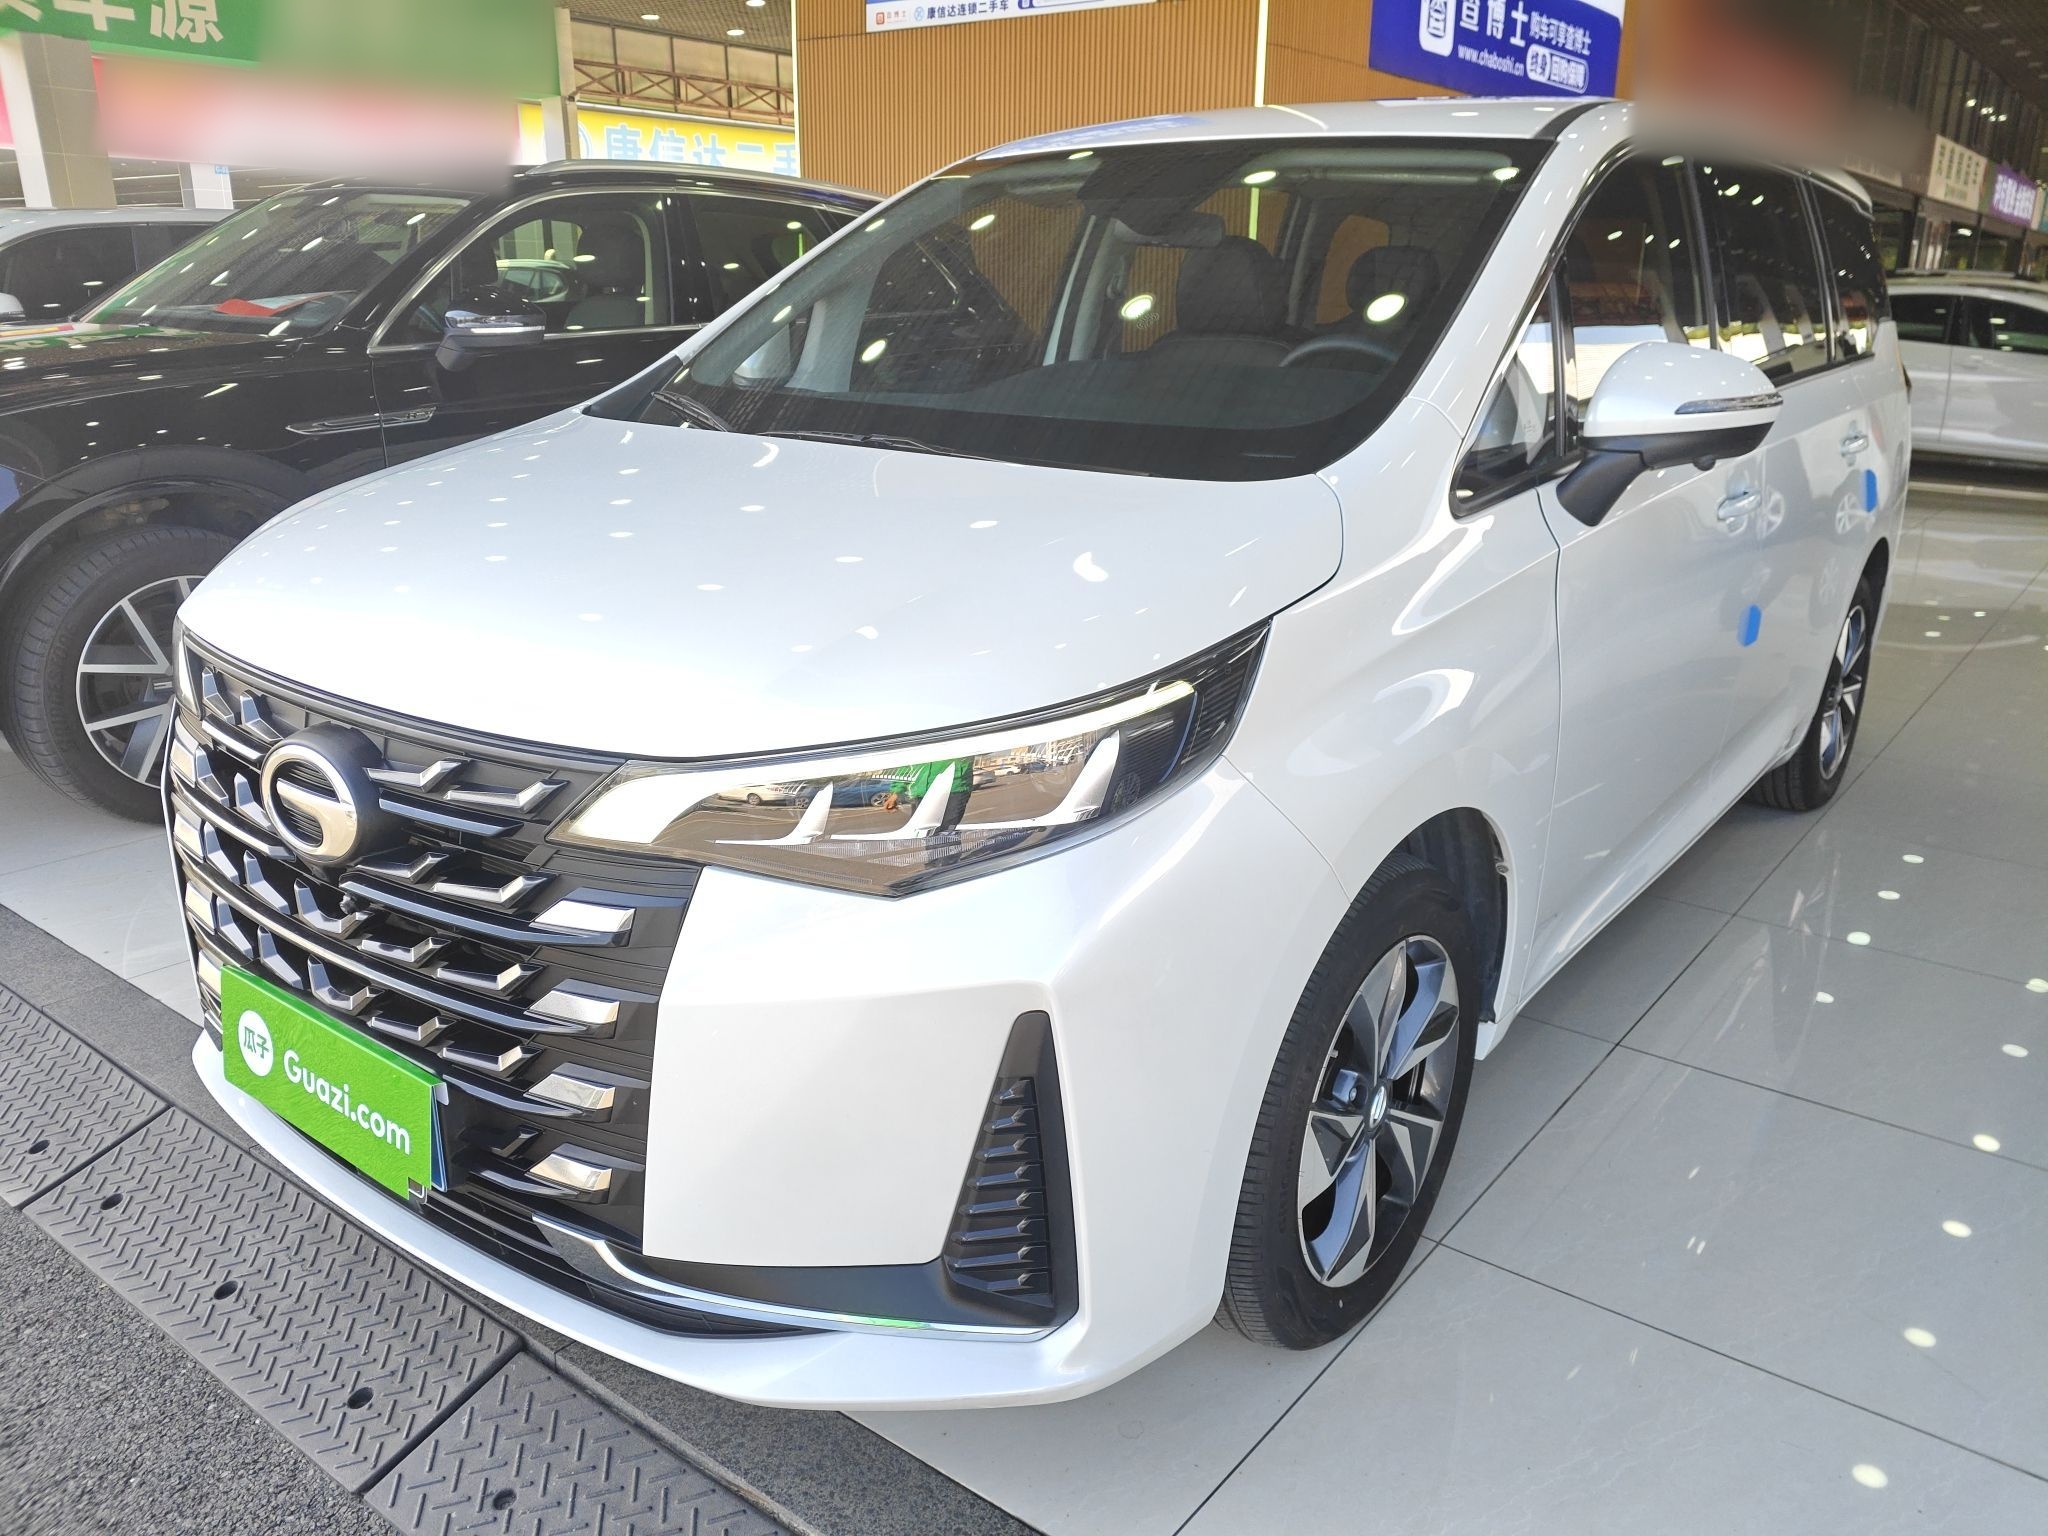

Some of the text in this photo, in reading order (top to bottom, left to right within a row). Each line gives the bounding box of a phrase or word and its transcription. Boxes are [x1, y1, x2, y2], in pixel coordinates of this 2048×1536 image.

[927, 0, 1009, 19] 康信达连锁二手车
[1457, 44, 1524, 77] www.chaboshi.cn
[244, 1026, 270, 1059] 瓜子
[283, 1049, 411, 1156] Guazi.com
